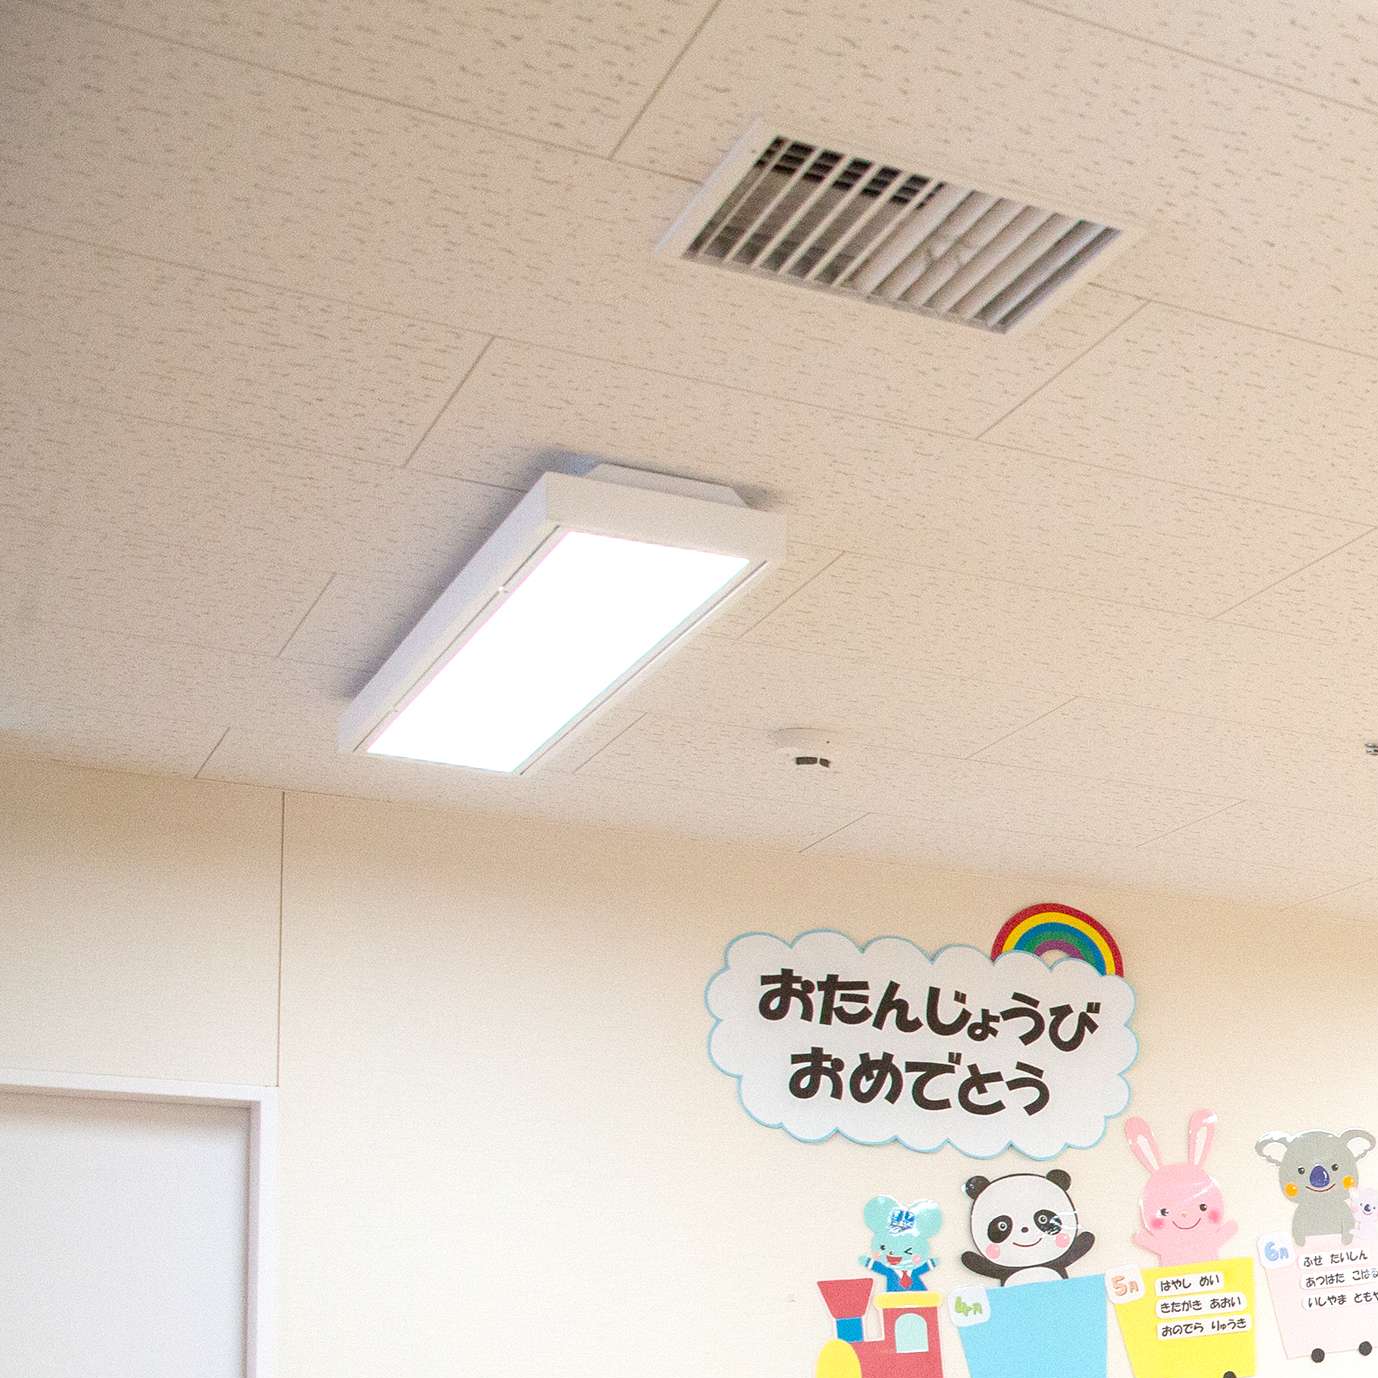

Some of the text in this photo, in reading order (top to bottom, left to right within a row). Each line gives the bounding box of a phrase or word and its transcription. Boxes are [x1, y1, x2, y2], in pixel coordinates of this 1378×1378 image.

[758, 968, 1101, 1052] おたんじょうび
[788, 1046, 1050, 1117] おめでとう
[1264, 1241, 1289, 1261] 6月
[1303, 1250, 1368, 1267] ふせ たいしん
[1160, 1274, 1219, 1292] はやし めい
[1352, 1268, 1378, 1281] こはる
[1112, 1275, 1139, 1296] 5月
[1160, 1296, 1241, 1314] きたがき あおい
[1308, 1294, 1347, 1308] いしやま
[1162, 1318, 1246, 1337] おのでら りゅうき
